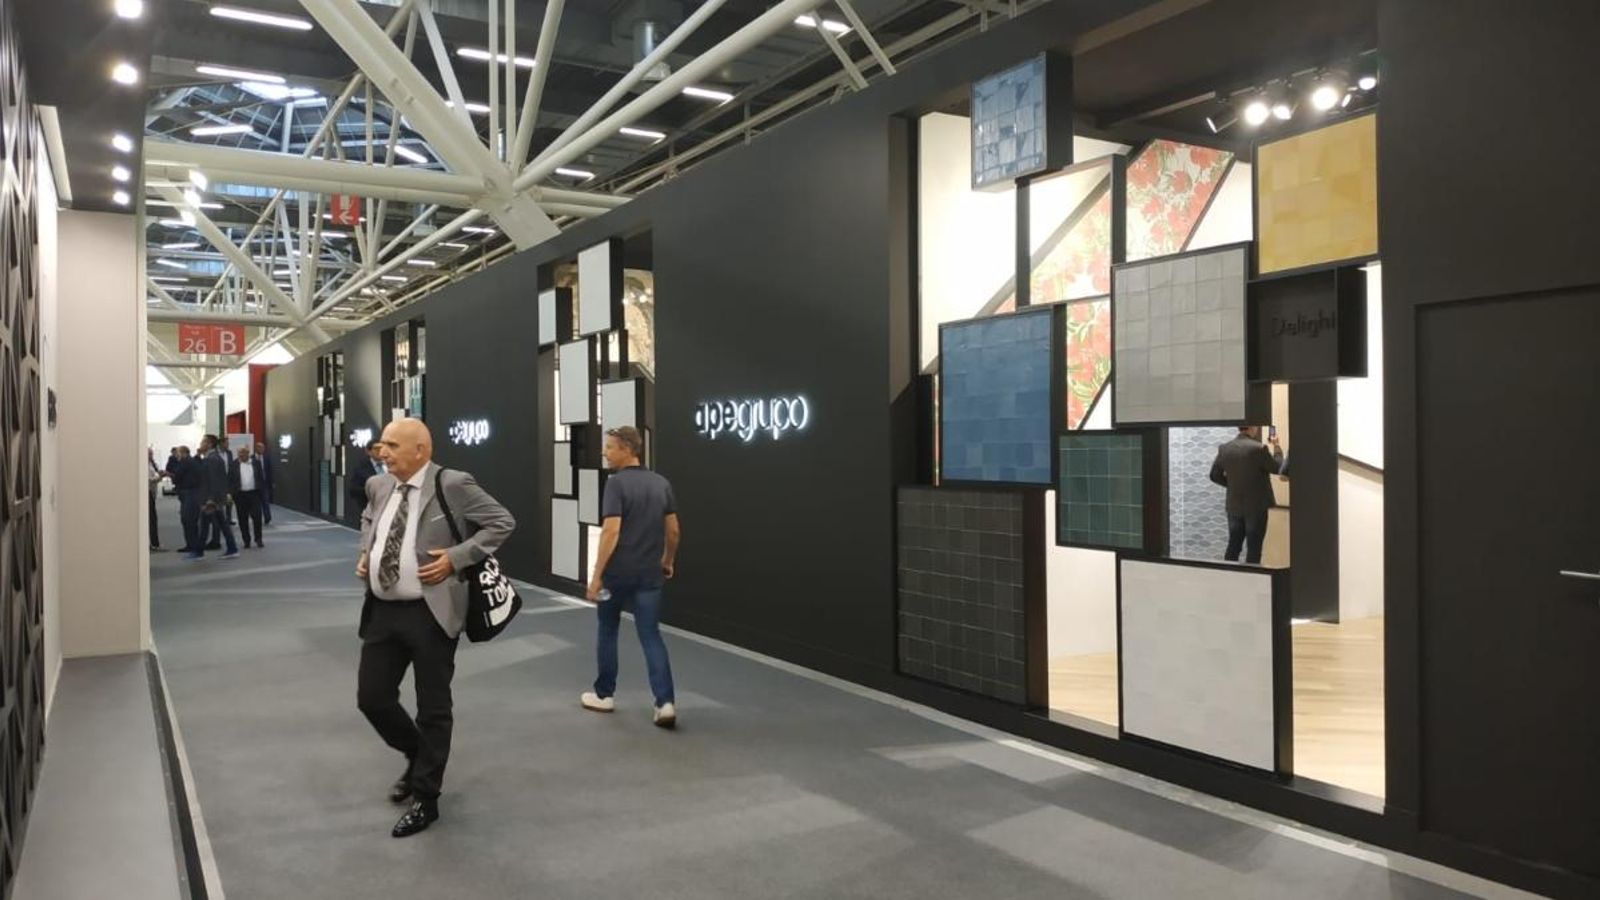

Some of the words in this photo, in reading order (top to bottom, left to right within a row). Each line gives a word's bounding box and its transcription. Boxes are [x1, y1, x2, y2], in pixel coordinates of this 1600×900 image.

[185, 338, 207, 354] 26
[220, 330, 237, 355] B
[695, 396, 809, 442] apegrupo
